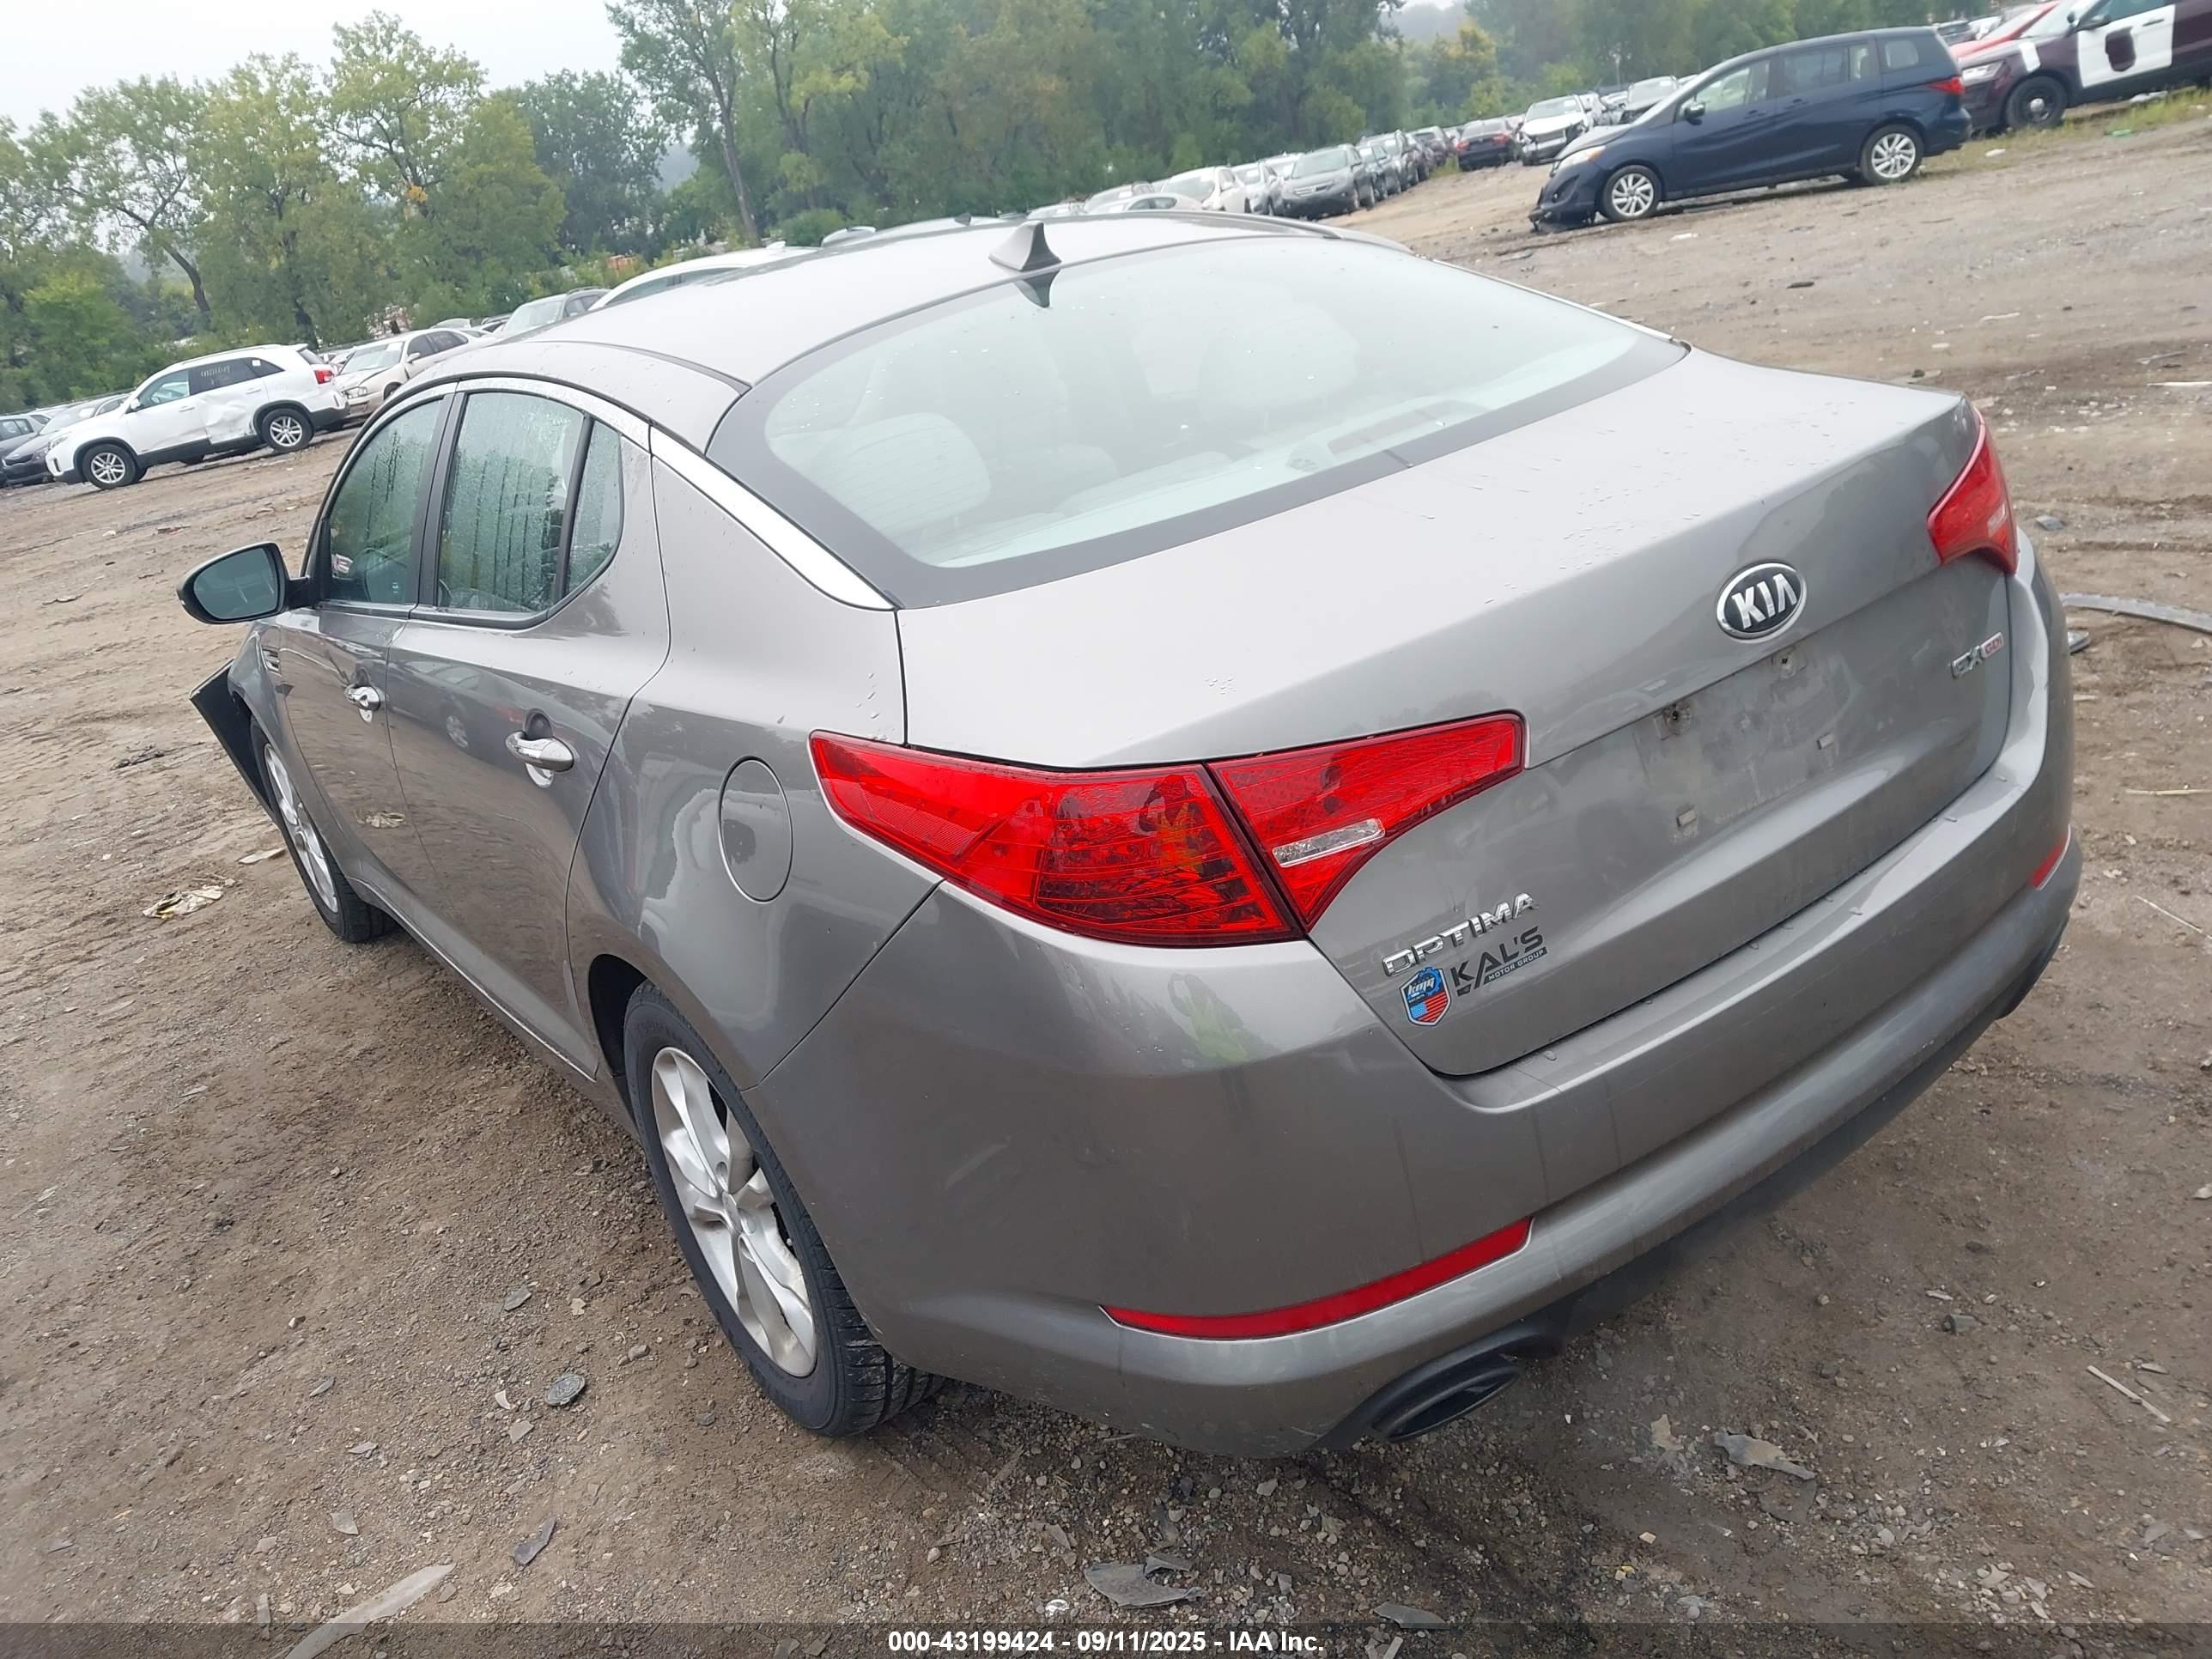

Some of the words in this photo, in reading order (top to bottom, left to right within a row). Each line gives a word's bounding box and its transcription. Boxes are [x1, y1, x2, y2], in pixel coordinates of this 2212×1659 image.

[1731, 573, 1798, 629] KIA
[1382, 892, 1538, 977] OPTIMA
[1450, 926, 1543, 989] KAL'S
[1488, 963, 1516, 981] MOTOR
[1517, 948, 1545, 967] GROUP
